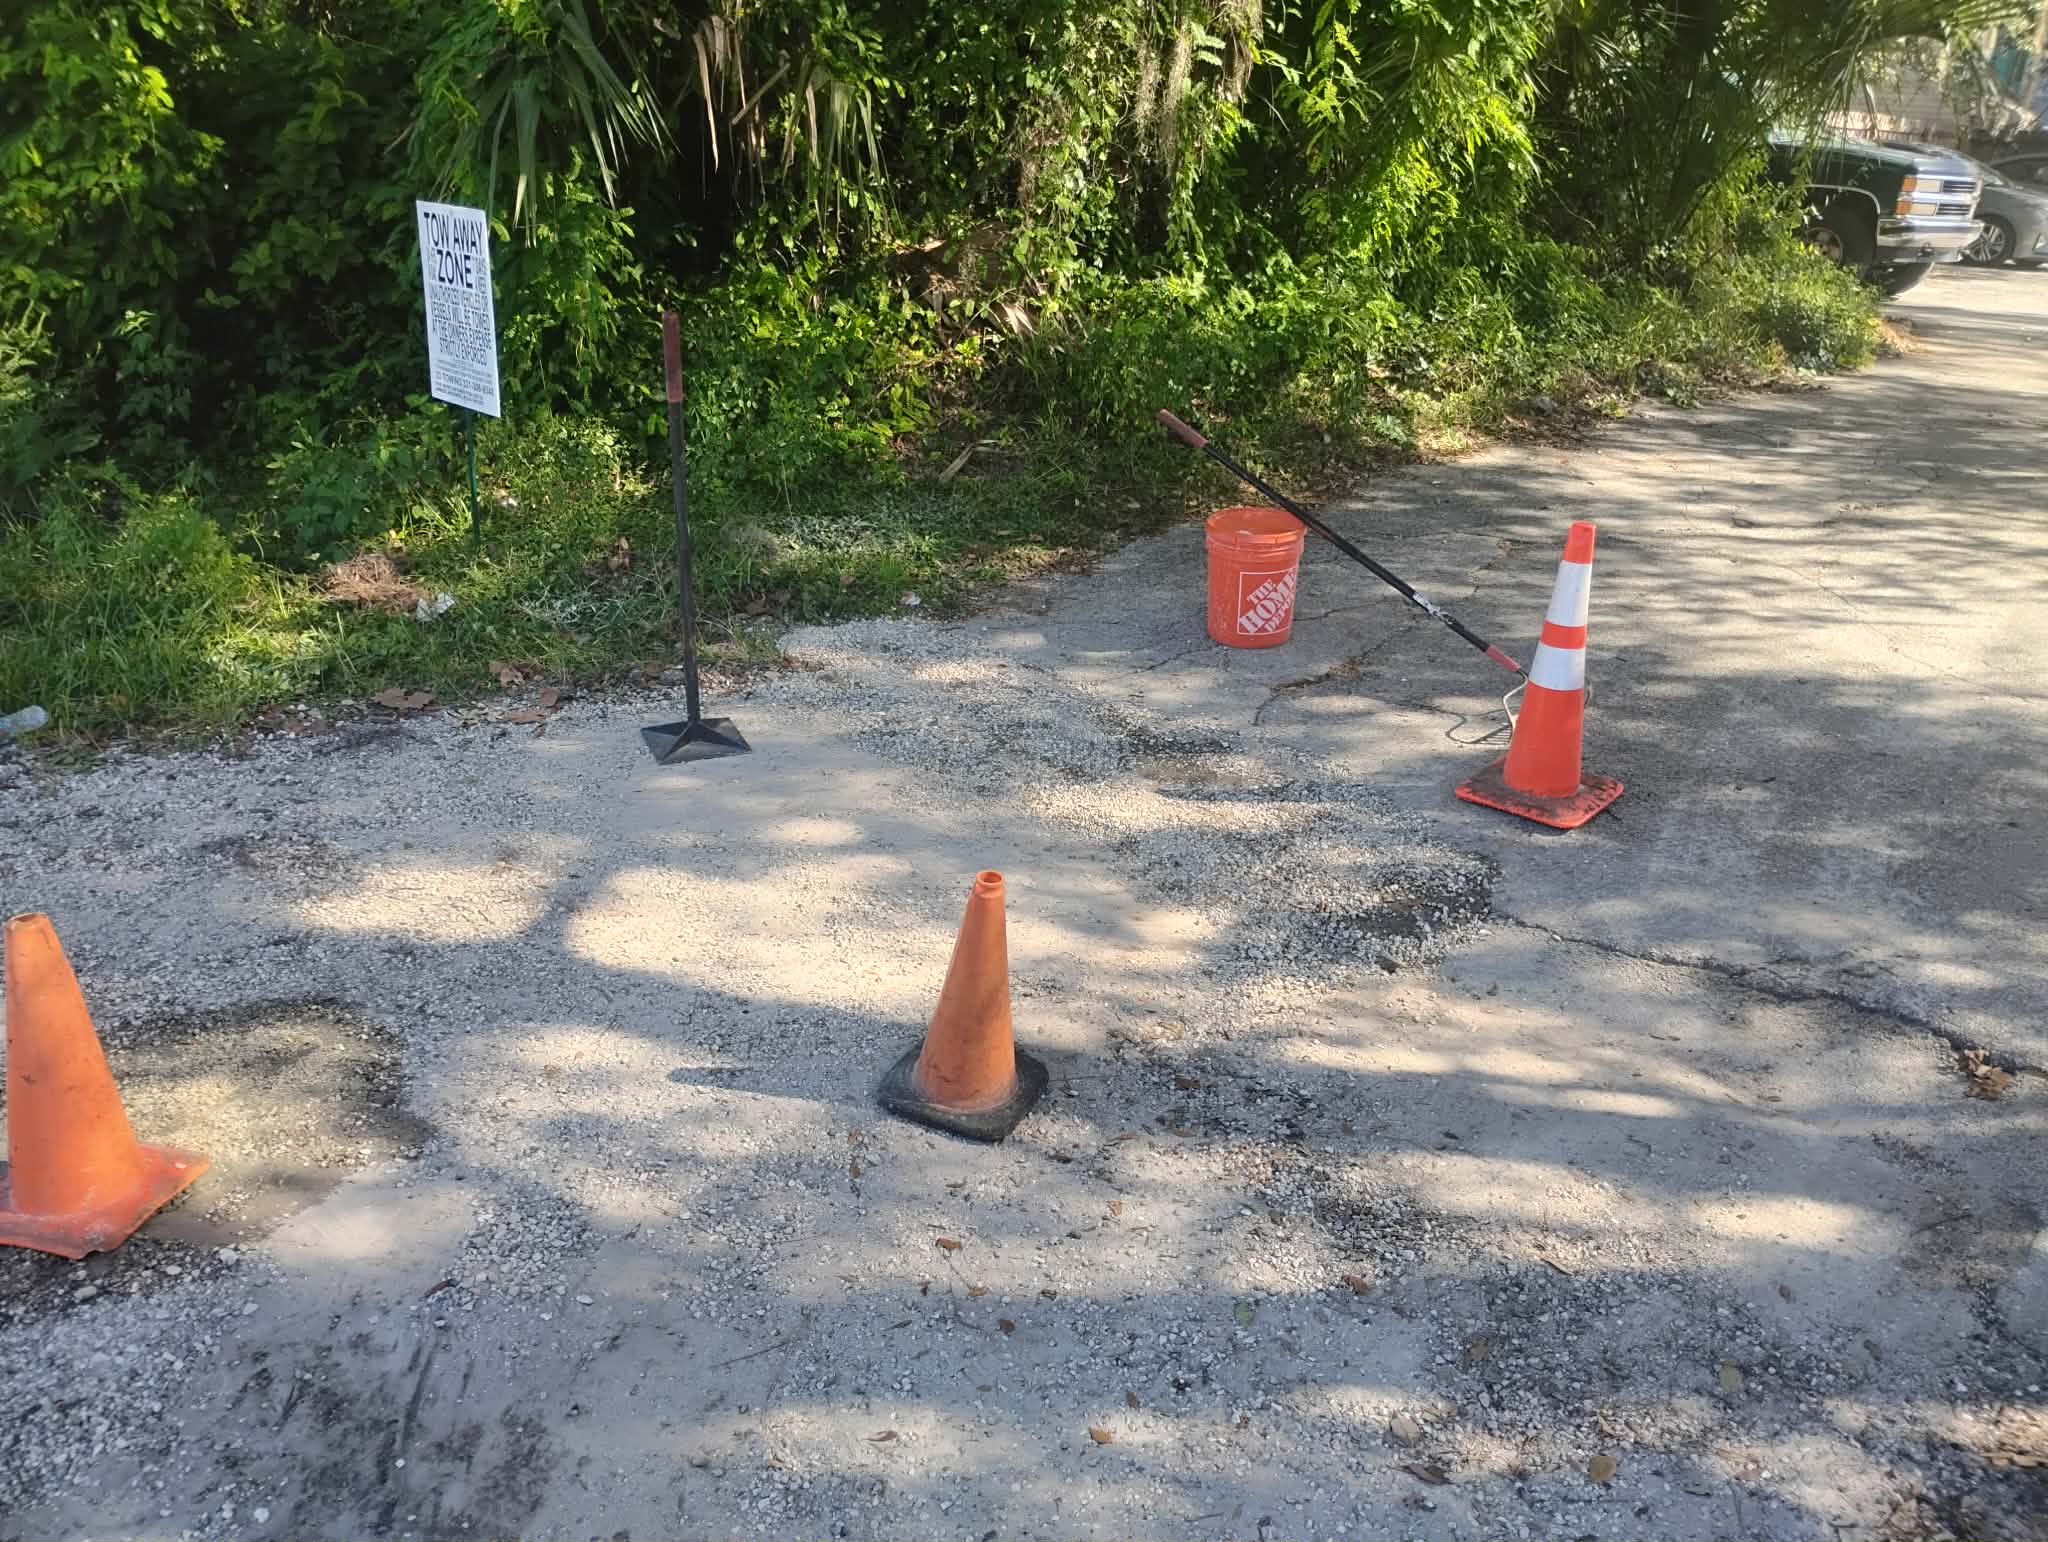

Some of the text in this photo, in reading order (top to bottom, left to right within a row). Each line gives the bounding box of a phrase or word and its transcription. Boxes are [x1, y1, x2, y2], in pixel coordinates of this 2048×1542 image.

[424, 213, 483, 255] TOW AWAY
[437, 249, 472, 288] ZONE
[464, 308, 471, 326] BE
[472, 310, 490, 331] TOWED
[461, 342, 487, 366] ENFORCED
[1240, 569, 1296, 633] HOME
[1247, 578, 1273, 605] THE
